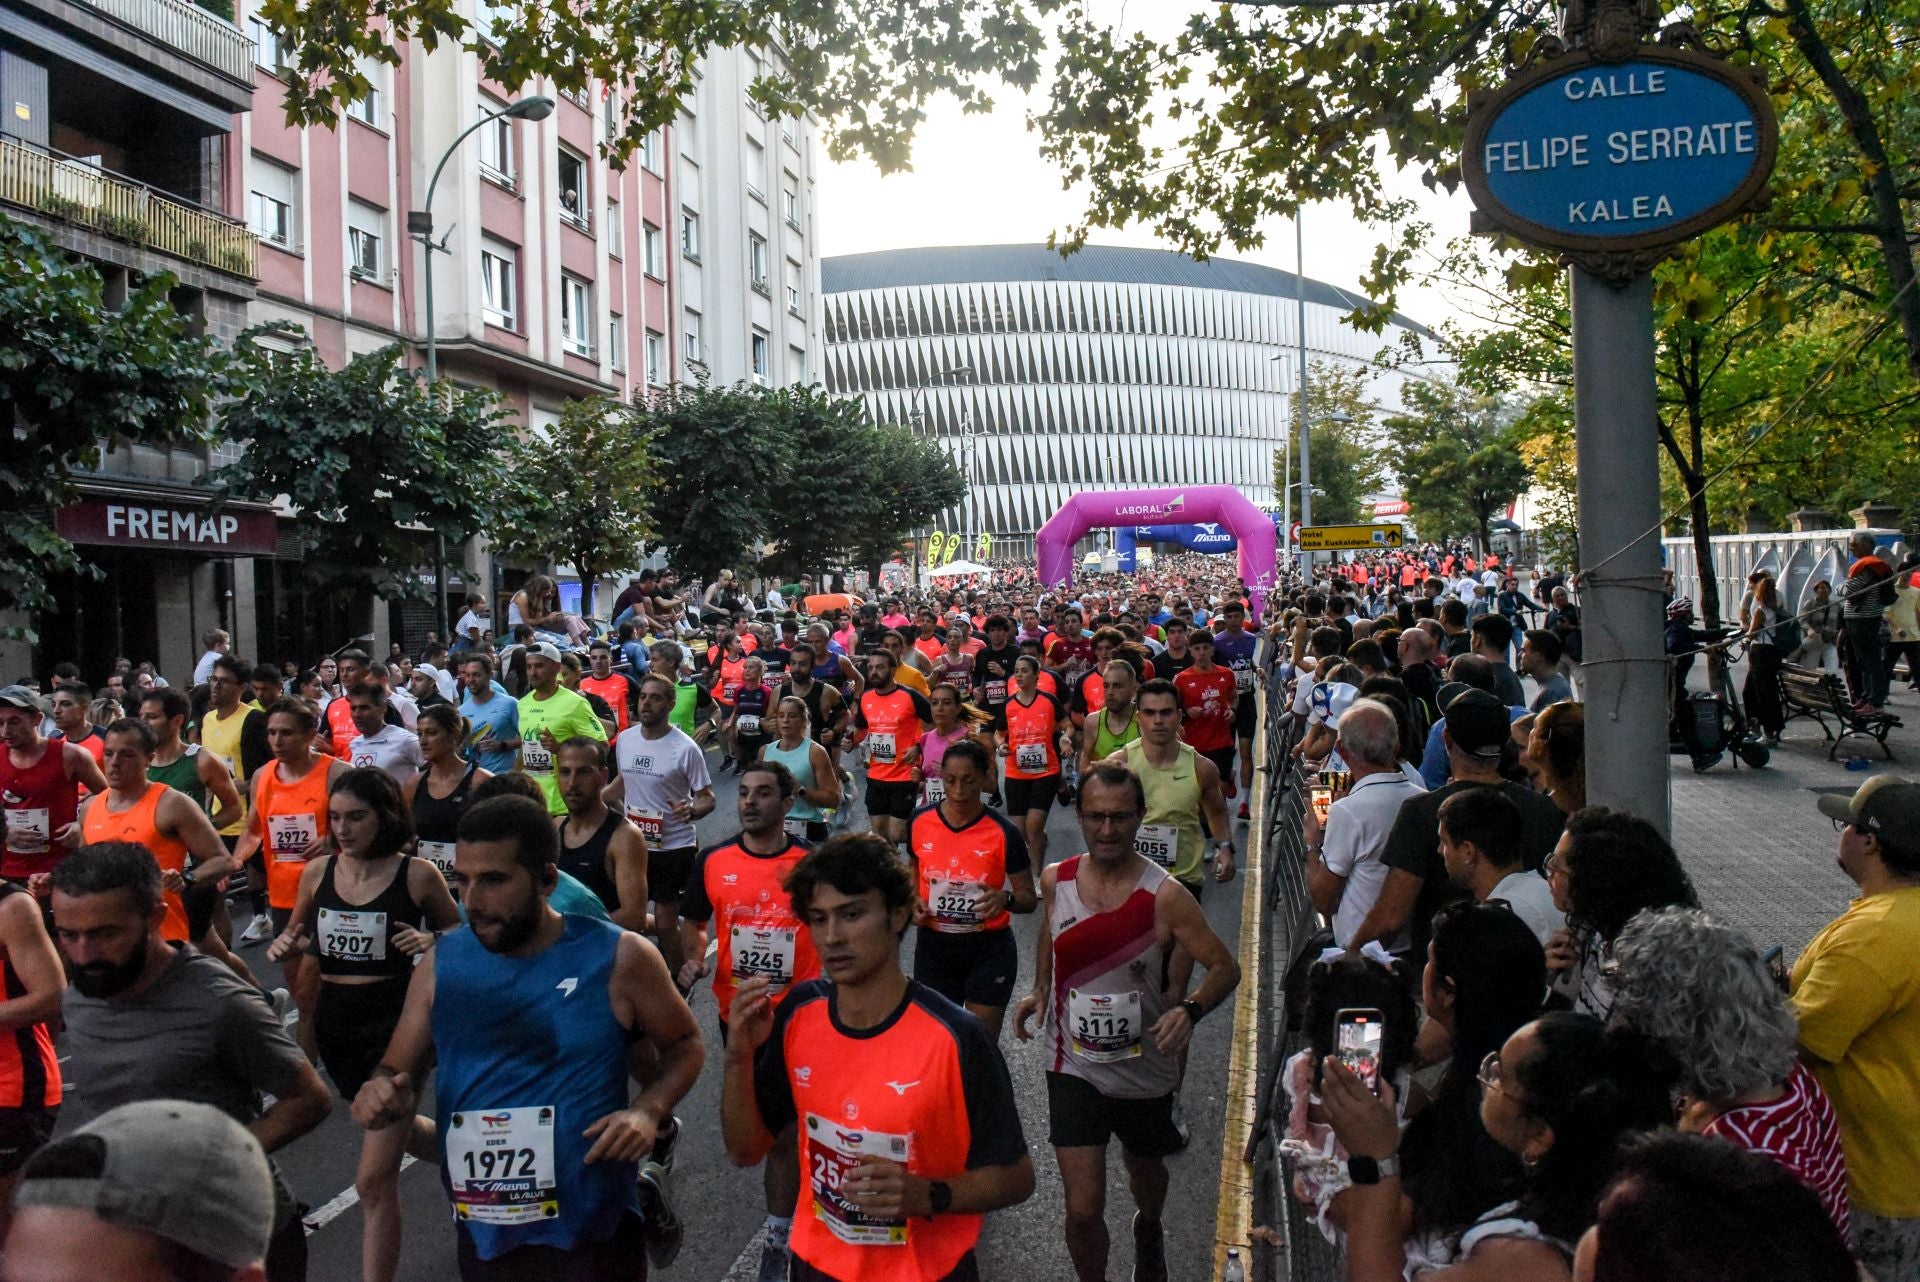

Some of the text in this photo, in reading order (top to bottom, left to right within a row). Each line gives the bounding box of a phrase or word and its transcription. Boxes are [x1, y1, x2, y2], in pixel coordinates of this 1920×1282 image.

[1564, 71, 1666, 100] CALLE
[1485, 120, 1754, 174] FELIPE SERRATE
[1569, 195, 1673, 224] KALEA
[1115, 504, 1162, 515] LABORAL
[107, 505, 238, 544] FREMAP
[1301, 530, 1323, 538] Hotel
[873, 743, 890, 751] 3360
[635, 757, 651, 768] MB
[277, 830, 309, 843] 2972
[937, 896, 976, 912] 3222
[327, 934, 374, 953] 2907
[739, 950, 783, 969] 3245
[1079, 1016, 1129, 1036] 3112
[486, 1138, 507, 1146] EDER
[464, 1147, 536, 1178] 1972
[815, 1153, 848, 1190] 25
